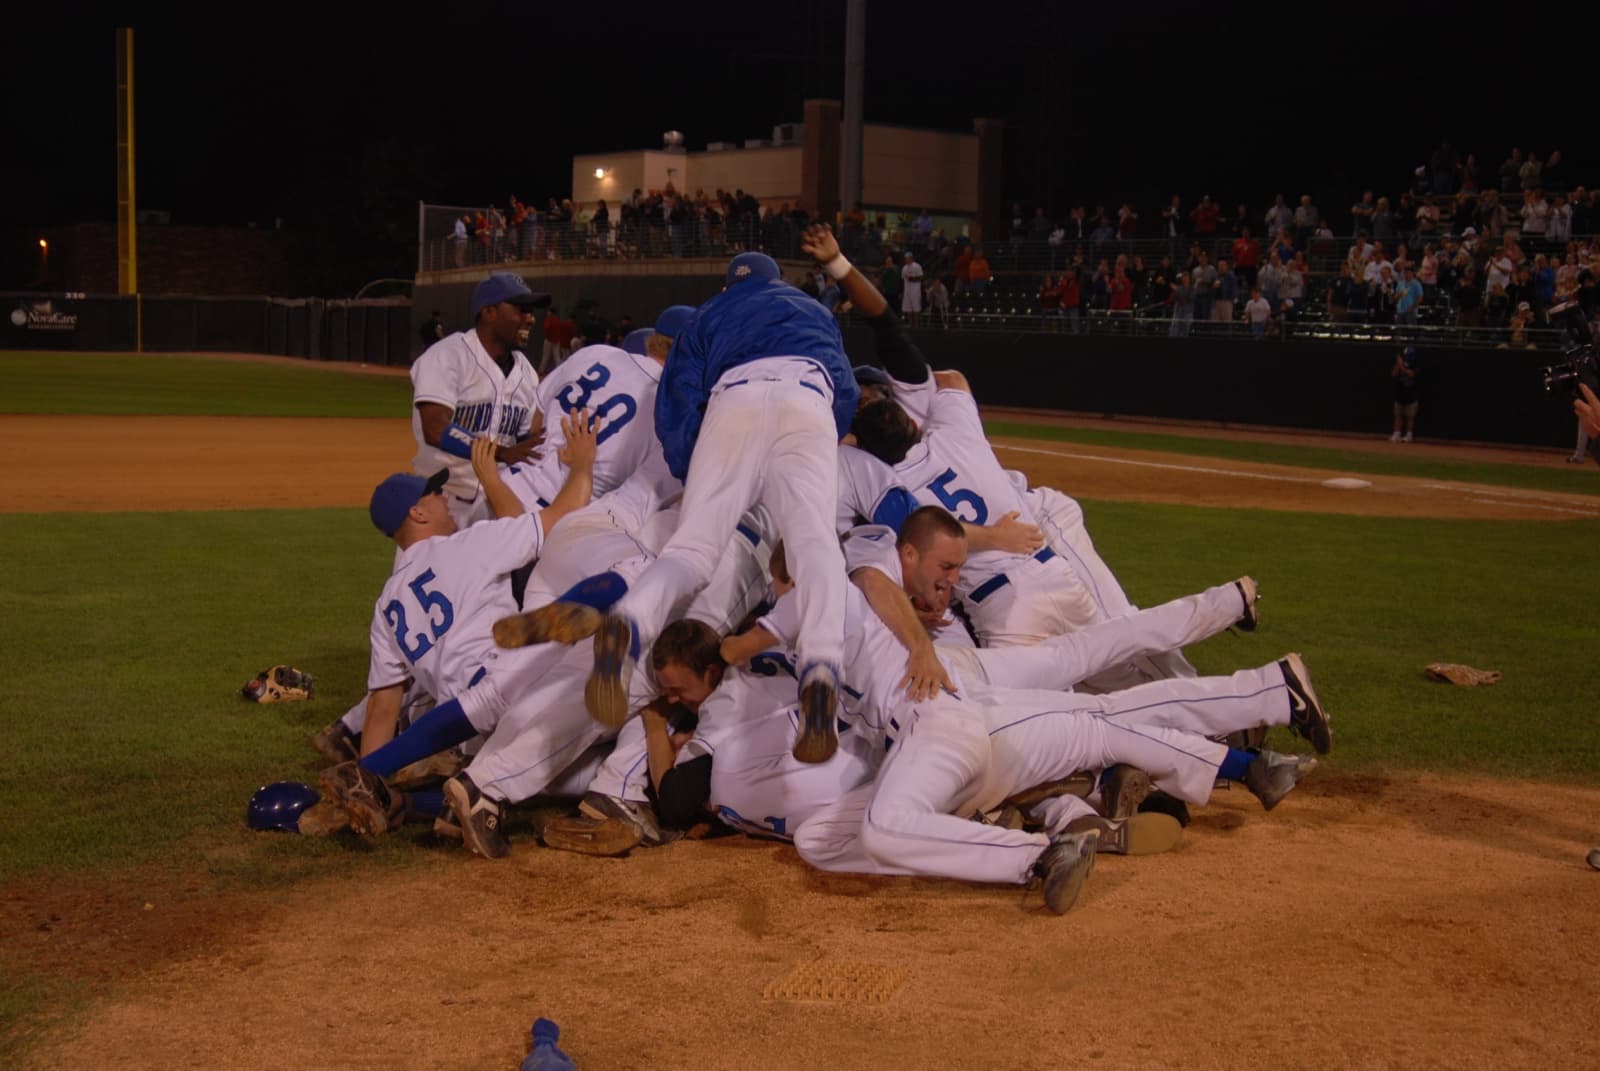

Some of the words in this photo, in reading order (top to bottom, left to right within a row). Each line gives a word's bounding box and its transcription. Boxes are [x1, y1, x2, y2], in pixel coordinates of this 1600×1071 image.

[555, 361, 637, 446] 30
[927, 467, 988, 526] 5
[383, 567, 454, 666] 25
